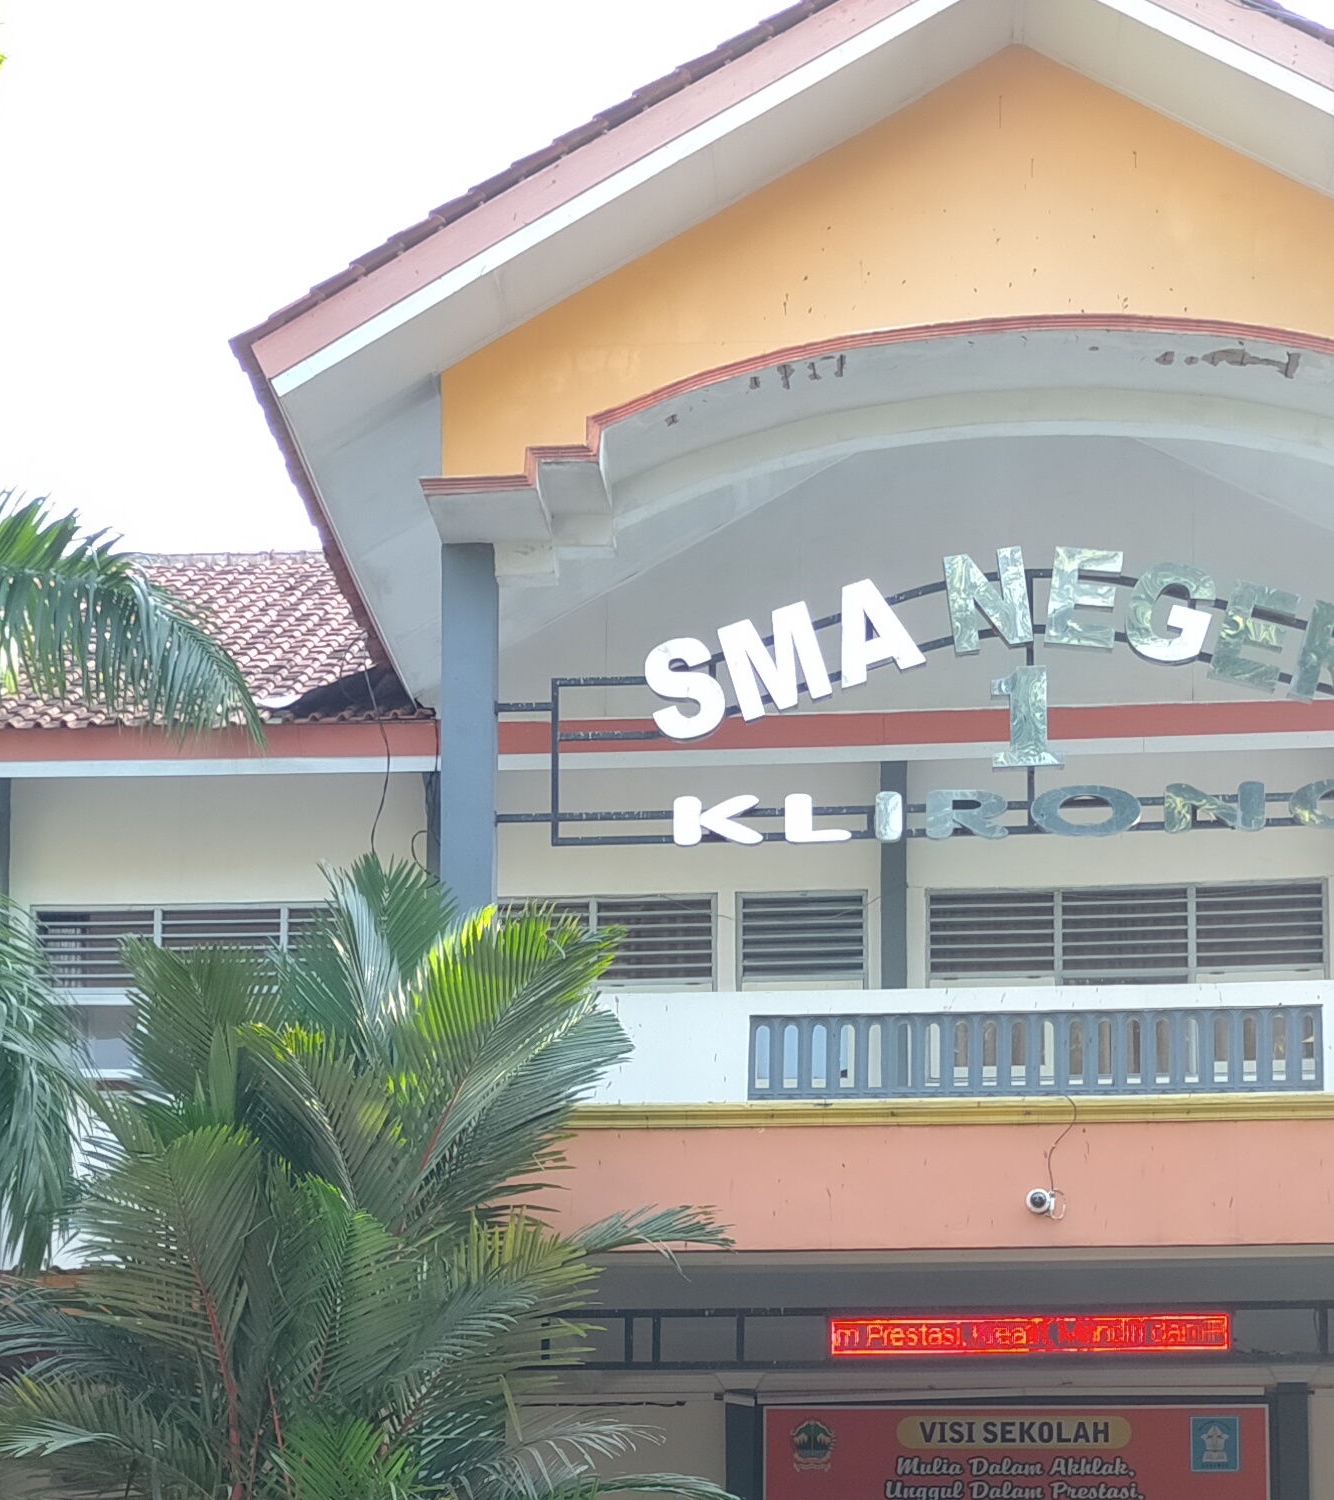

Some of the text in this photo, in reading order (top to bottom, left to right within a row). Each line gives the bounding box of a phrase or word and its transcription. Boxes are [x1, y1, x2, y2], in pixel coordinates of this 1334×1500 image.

[643, 578, 926, 744] SMA
[989, 665, 1064, 769] 1
[867, 1324, 967, 1347] Prestasi,
[919, 1421, 1110, 1444] VISI SEKOLAH
[896, 1456, 1136, 1478] Mulia Dalam Akhlak,
[968, 1481, 1043, 1500] Dalam
[1050, 1480, 1145, 1500] Prestasi,
